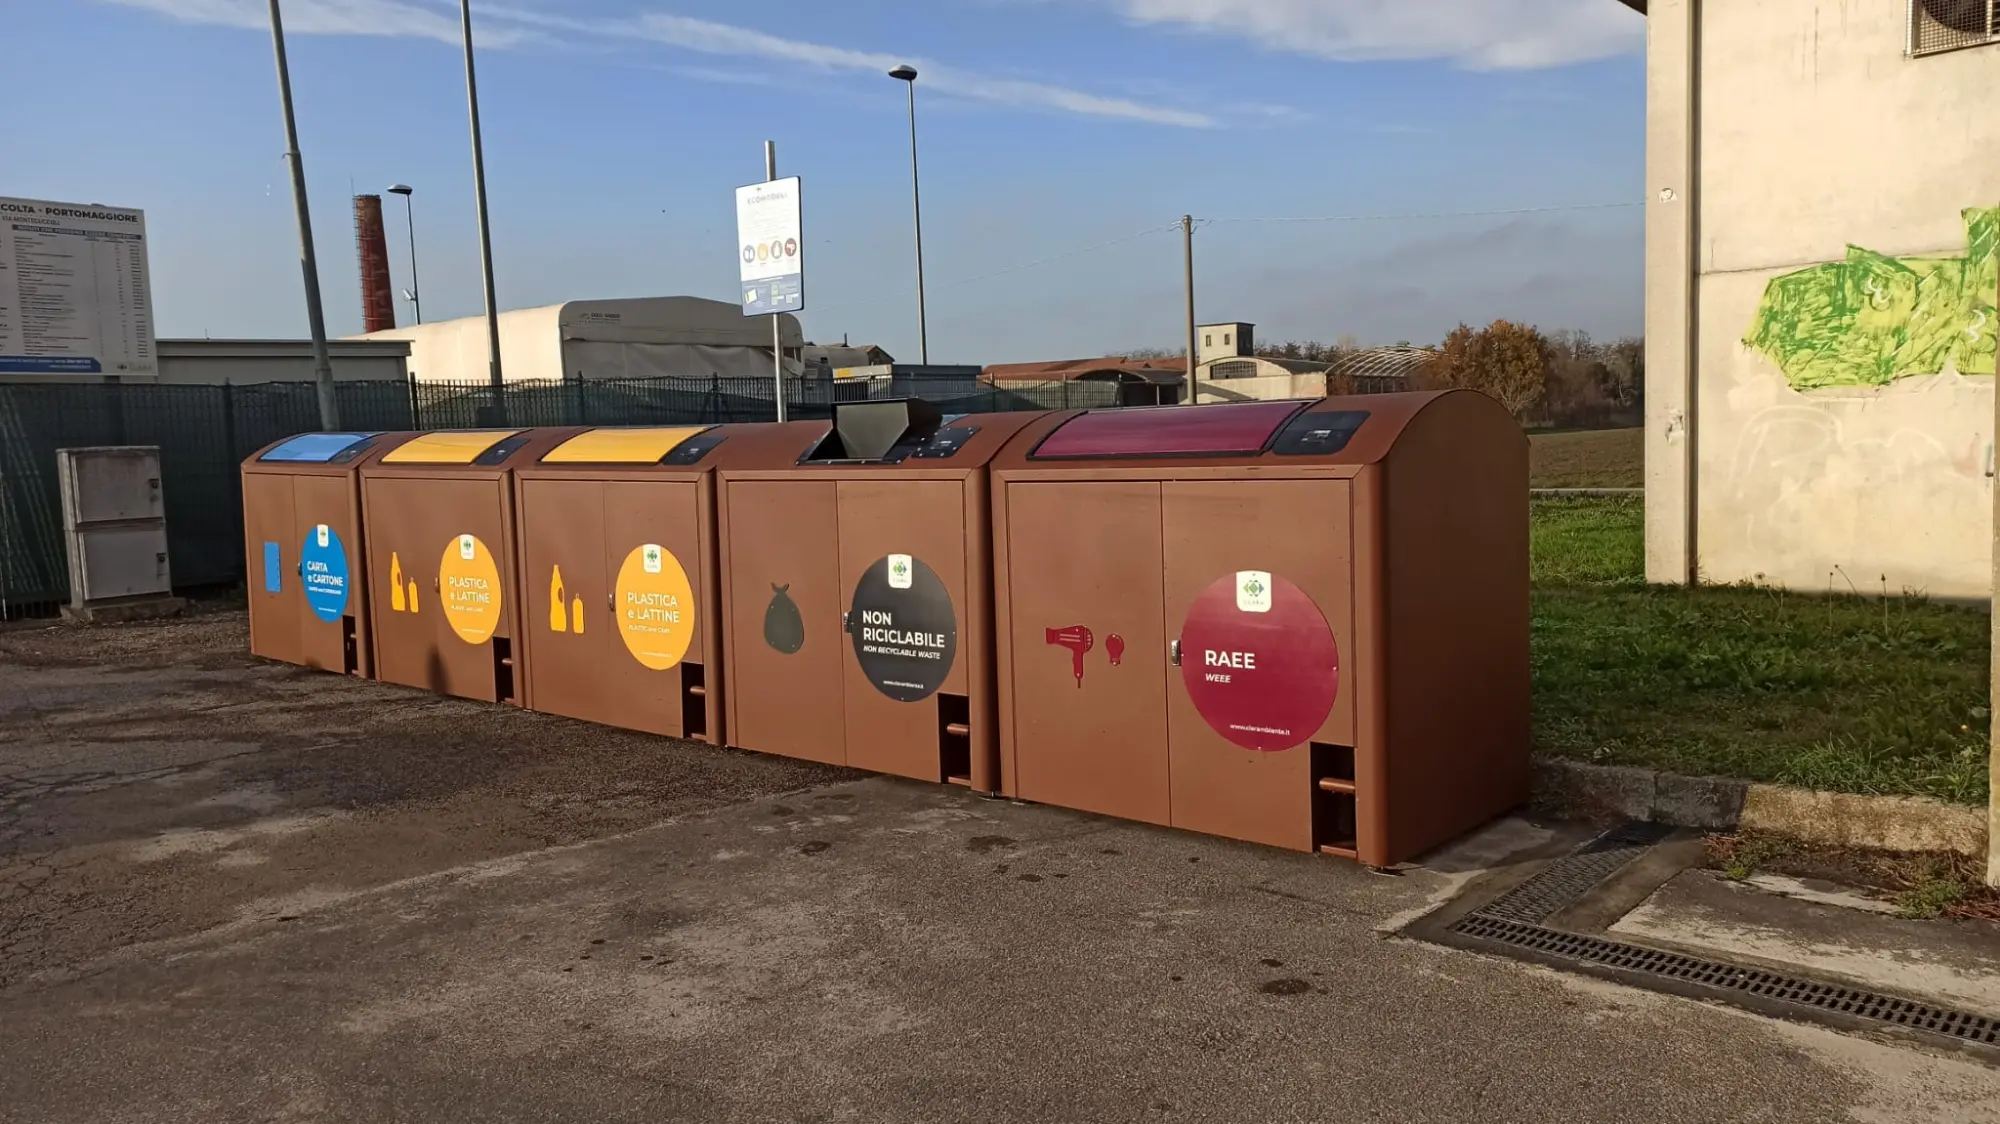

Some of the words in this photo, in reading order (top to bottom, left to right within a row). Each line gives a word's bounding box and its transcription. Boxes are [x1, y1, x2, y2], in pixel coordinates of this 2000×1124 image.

[1, 203, 36, 214] COLTA
[45, 207, 138, 222] PORTOMAGGIORE
[307, 560, 328, 573] CARTA
[307, 574, 312, 583] e
[313, 573, 344, 587] CARTONE
[448, 576, 488, 590] PLASTICA
[450, 591, 455, 600] e
[456, 590, 490, 604] LATTINE
[627, 591, 678, 607] PLASTICA
[627, 608, 634, 619] e
[637, 607, 680, 624] LATTINE
[863, 610, 892, 626] NON
[863, 627, 945, 648] RICICLABILE
[863, 645, 877, 653] NON
[878, 646, 916, 656] RECYCLABLE
[918, 650, 940, 659] WASTE
[1205, 649, 1256, 669] RAEE
[1205, 672, 1231, 683] WEEE
